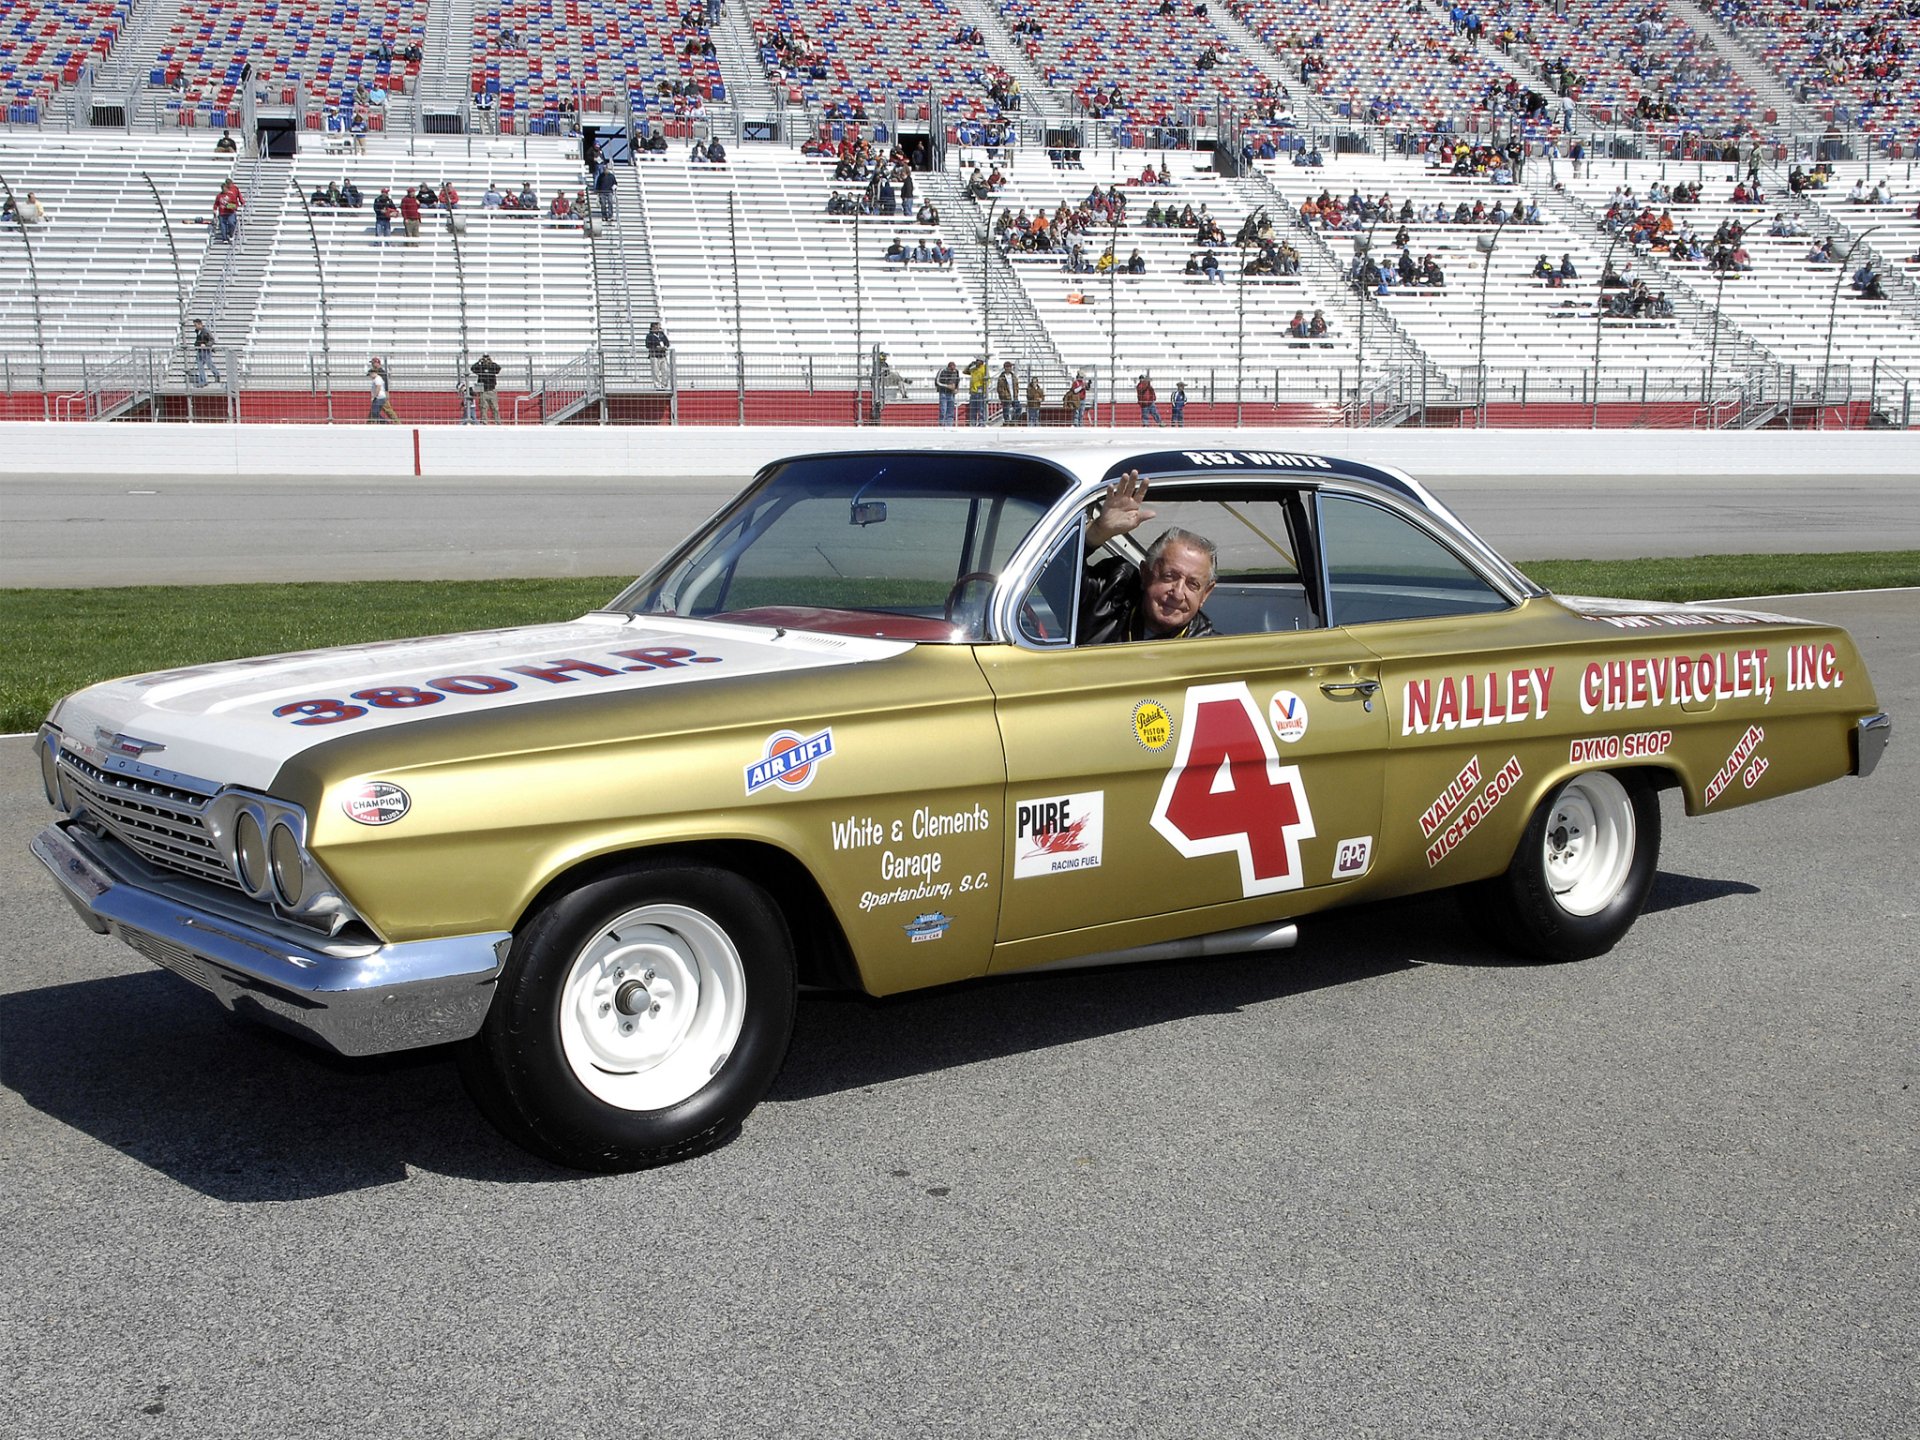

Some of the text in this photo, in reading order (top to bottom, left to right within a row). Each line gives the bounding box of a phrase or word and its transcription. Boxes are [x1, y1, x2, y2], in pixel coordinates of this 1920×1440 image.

[1182, 451, 1332, 469] REX WHITE
[272, 674, 519, 726] 380
[500, 646, 723, 684] H.P.
[1402, 643, 1844, 736] NALLEY CHEVROLET, INC.
[1136, 708, 1164, 730] Pedrick
[1143, 727, 1165, 735] PISTON
[1146, 735, 1165, 743] RINGS
[1570, 730, 1672, 763] DYNO SHOP
[751, 735, 828, 787] AIR LIFT
[1705, 725, 1764, 807] ATLANTA,
[1743, 757, 1769, 788] GA.
[352, 797, 402, 810] CHAMPION
[1154, 688, 1311, 893] 4
[1419, 756, 1481, 837] NALLEY
[381, 810, 400, 821] PLUGS
[831, 802, 989, 850] White & Clements
[1018, 798, 1070, 838] PURE
[1426, 756, 1523, 867] NICHOLSON
[881, 850, 942, 884] Garage
[1051, 855, 1100, 872] RACING FUEL
[1340, 844, 1366, 867] PPG
[859, 872, 989, 912] Spartanburg, S.C.
